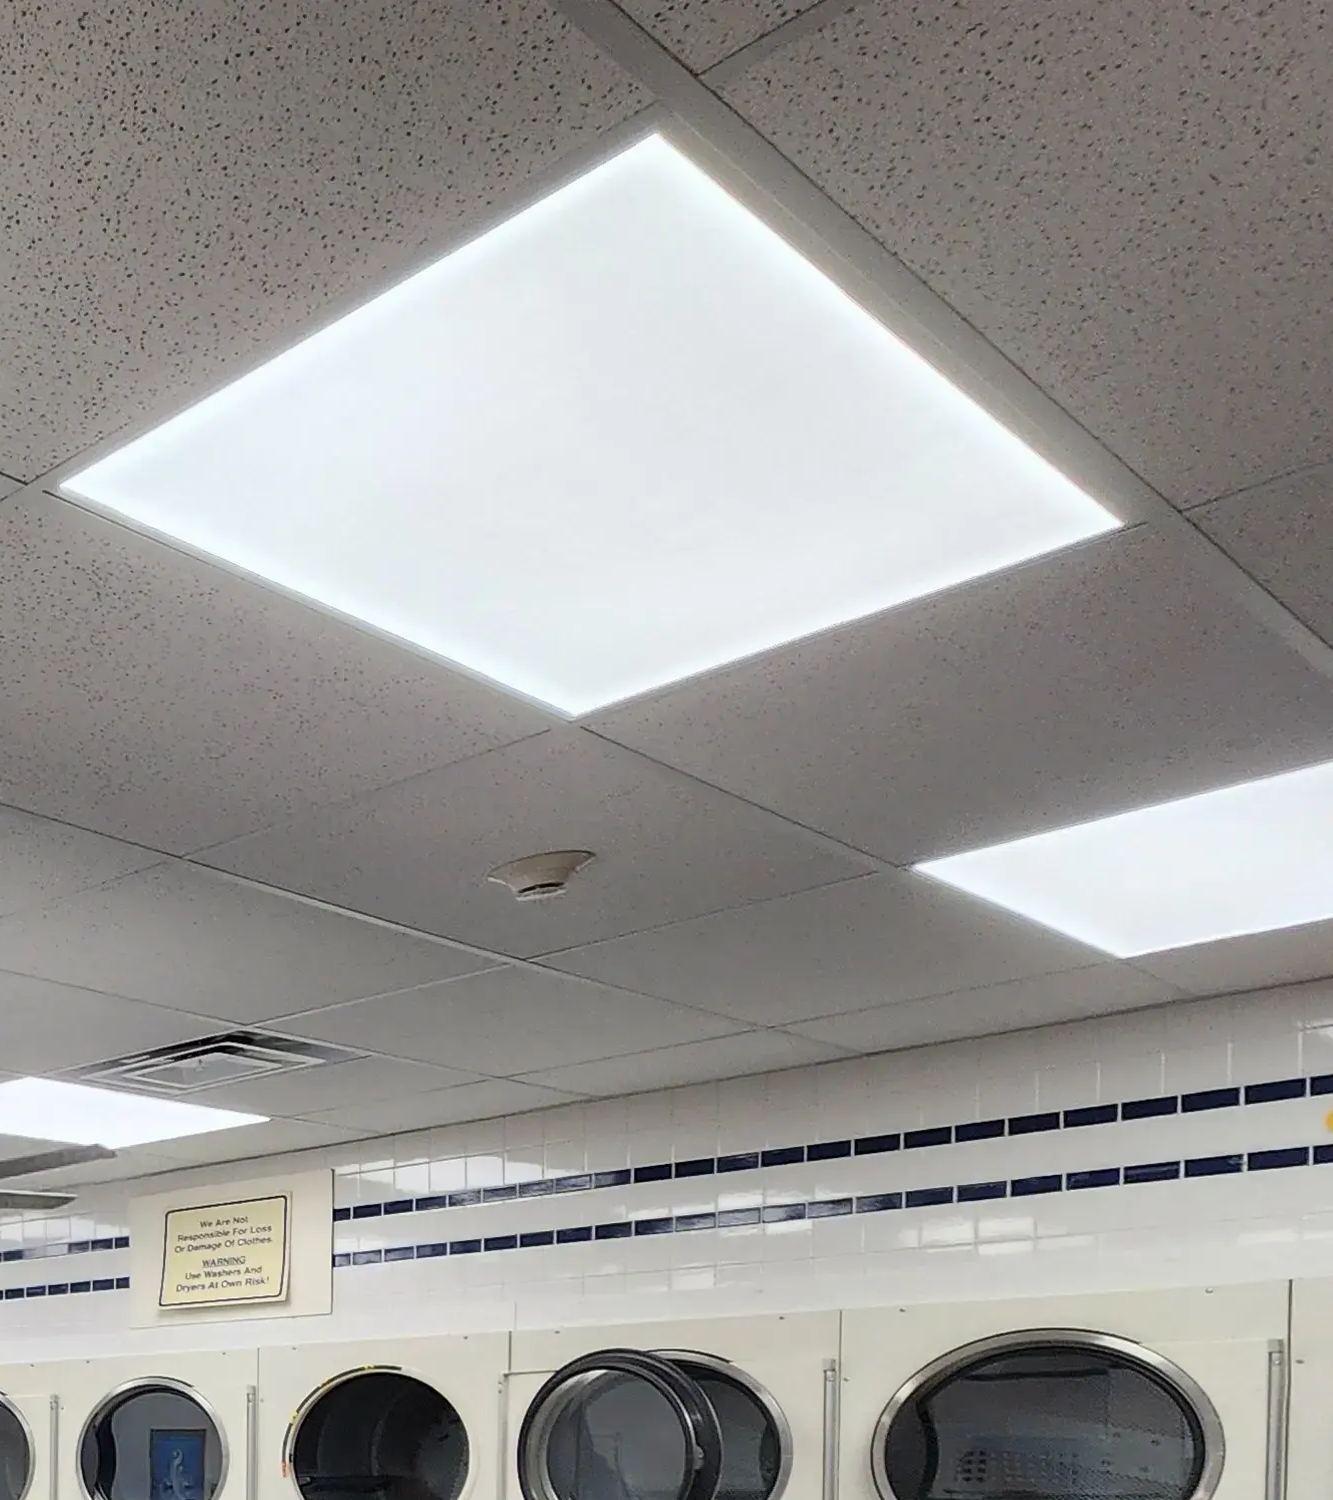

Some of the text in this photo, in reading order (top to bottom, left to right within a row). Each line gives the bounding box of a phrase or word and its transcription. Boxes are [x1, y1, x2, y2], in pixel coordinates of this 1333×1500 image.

[200, 1216, 248, 1228] We Are Not
[177, 1224, 272, 1243] Responsible For Loss
[174, 1245, 185, 1253] Or
[187, 1242, 222, 1253] Damage
[225, 1239, 235, 1248] Of
[202, 1256, 247, 1268] WARNING
[185, 1266, 263, 1280] Use Washers And
[176, 1276, 270, 1293] Dryers At Own Risk!
